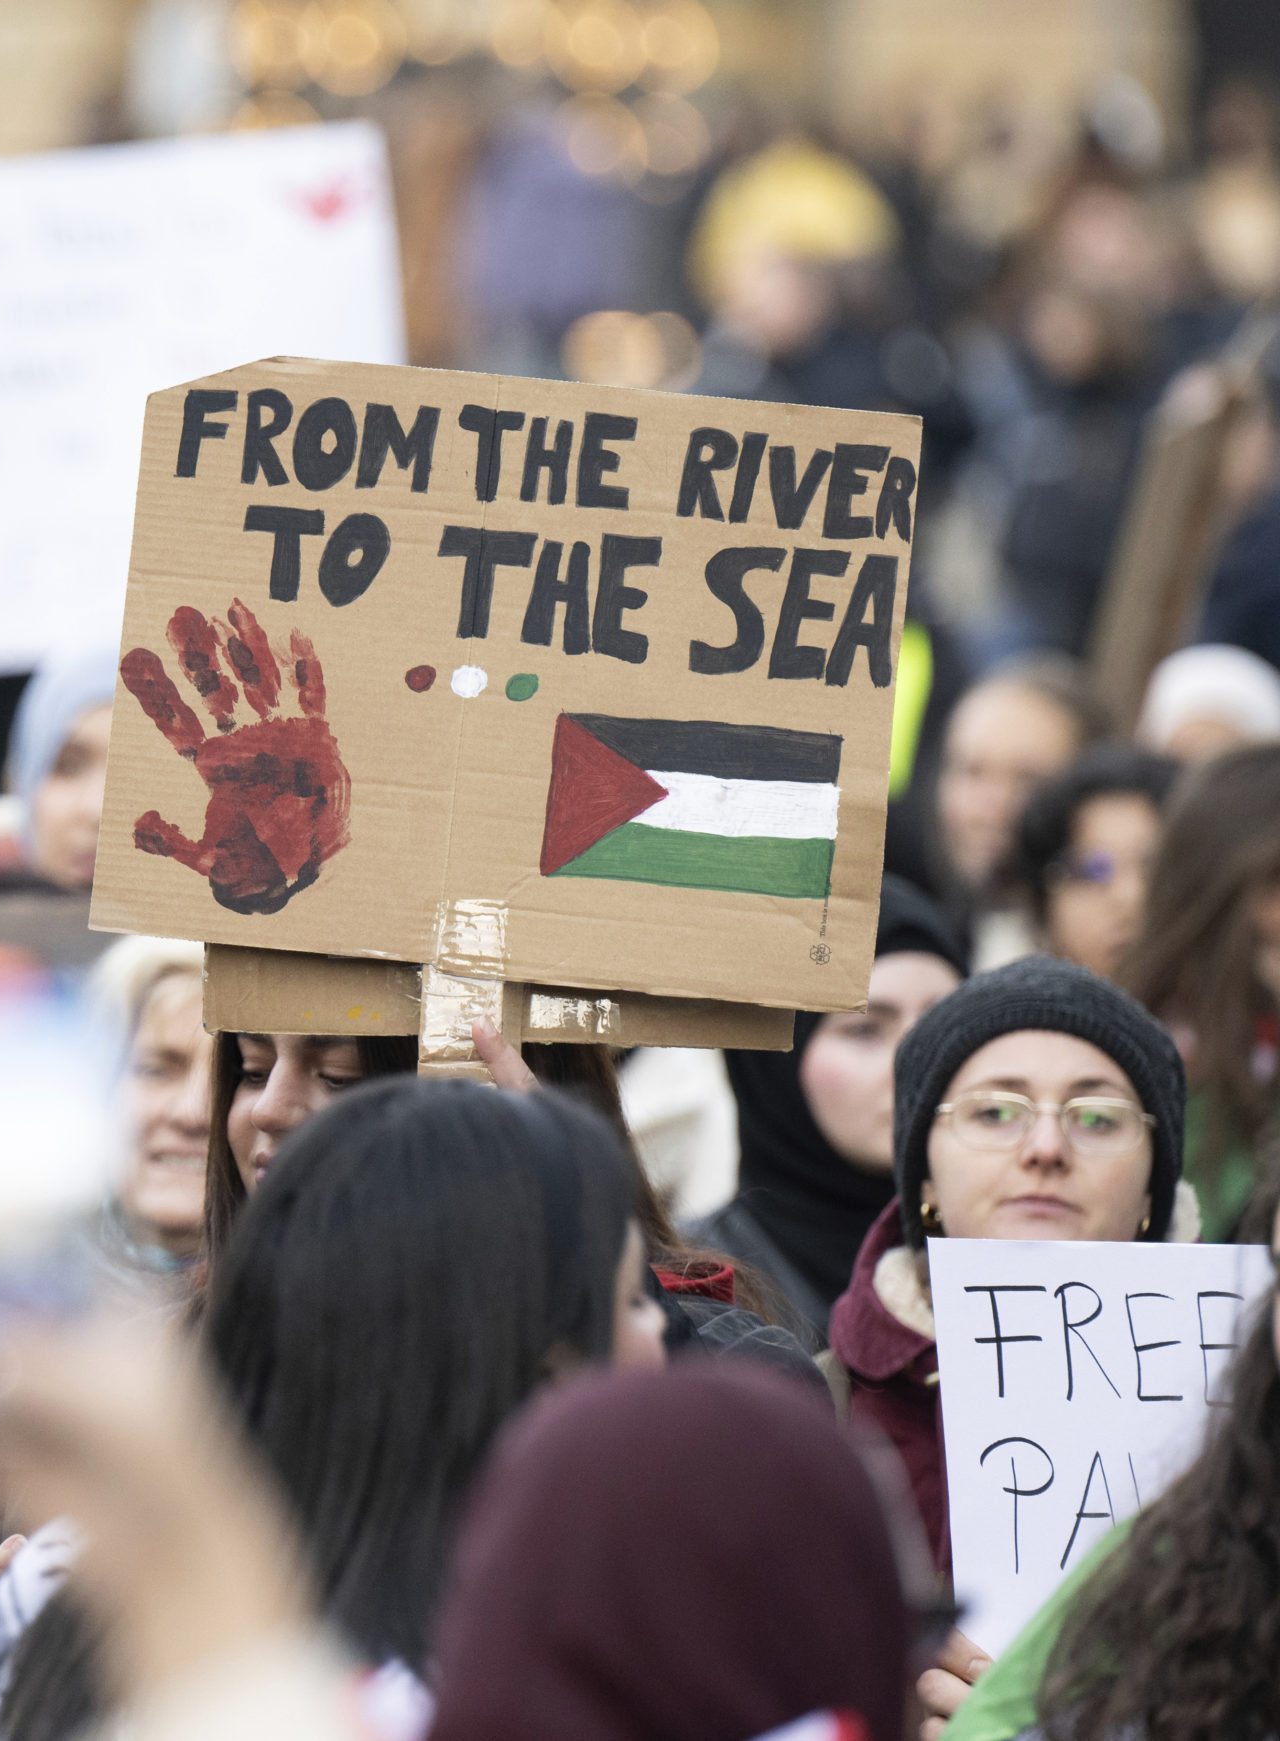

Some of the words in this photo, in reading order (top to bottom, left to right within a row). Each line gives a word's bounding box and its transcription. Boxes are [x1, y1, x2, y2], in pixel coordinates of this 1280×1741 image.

[174, 389, 441, 493] FROM
[458, 404, 638, 510] THE
[676, 427, 917, 543] RIVER
[244, 505, 391, 607] TO
[438, 525, 662, 664] THE
[689, 547, 900, 688] SEA
[964, 1281, 1245, 1407] FREE
